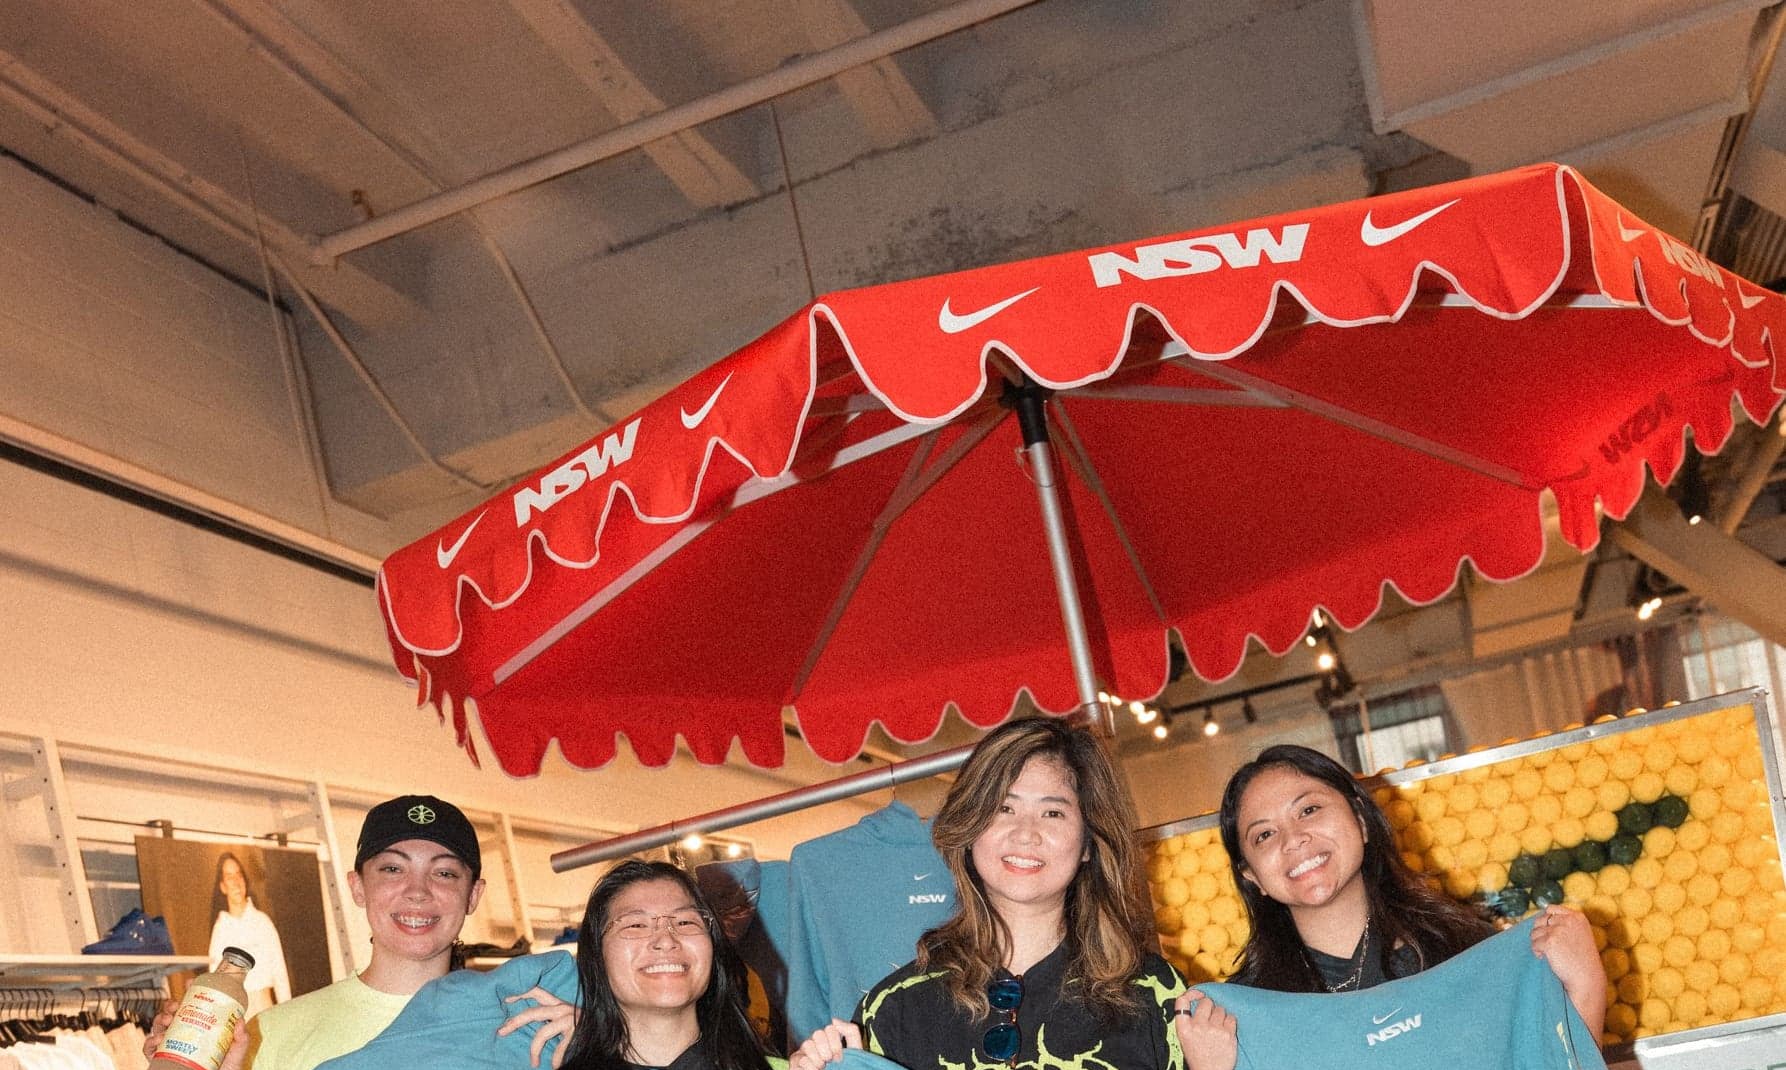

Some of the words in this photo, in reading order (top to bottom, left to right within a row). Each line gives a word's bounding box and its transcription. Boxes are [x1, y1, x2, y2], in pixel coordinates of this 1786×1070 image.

[1088, 224, 1310, 288] NSW
[1654, 229, 1726, 290] NSW
[512, 418, 642, 528] NSW
[908, 893, 947, 905] NSW
[1366, 1013, 1423, 1047] NSW
